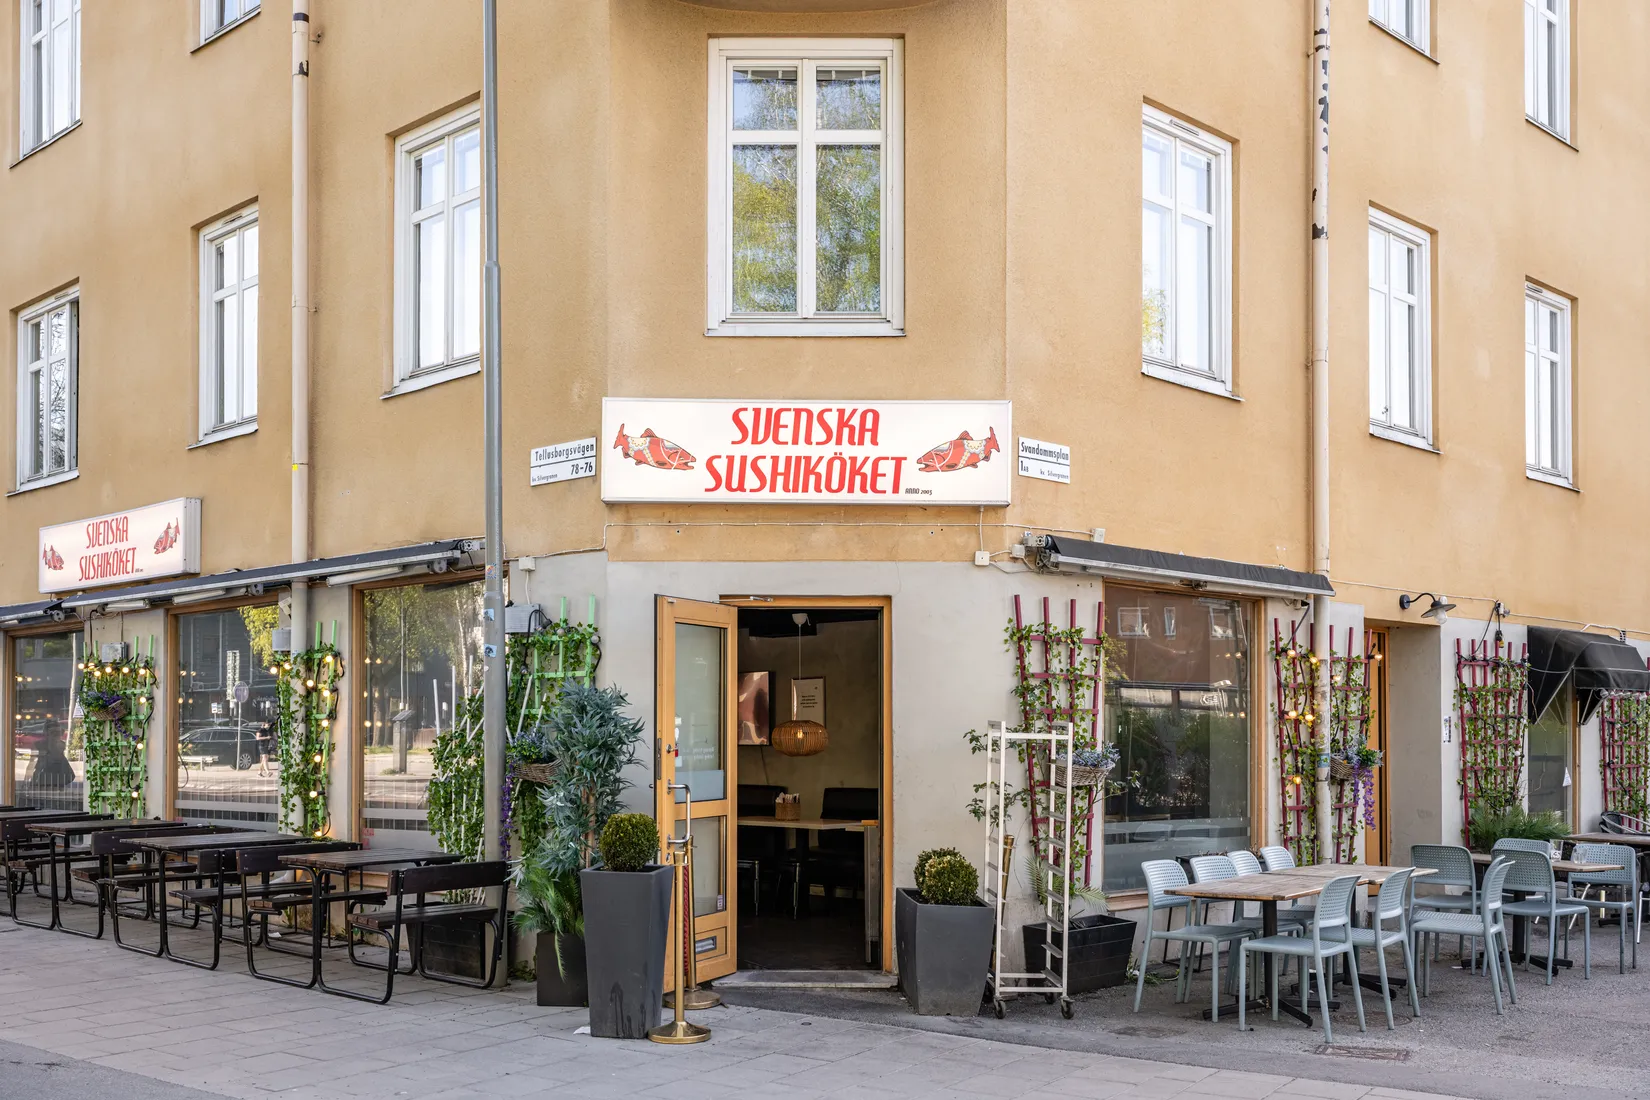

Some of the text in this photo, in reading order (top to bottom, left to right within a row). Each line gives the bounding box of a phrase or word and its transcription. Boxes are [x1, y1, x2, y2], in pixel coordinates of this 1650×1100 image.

[731, 407, 880, 446] SVENSKA
[535, 444, 594, 461] Tellusborgsvägen
[1021, 441, 1069, 462] Svandammsplan
[571, 461, 593, 475] 78-76
[705, 452, 907, 494] SUSHIKÖKET
[905, 487, 920, 495] ANNO
[86, 516, 129, 549] SVENSKA
[78, 547, 137, 582] SUSHIKÖKET
